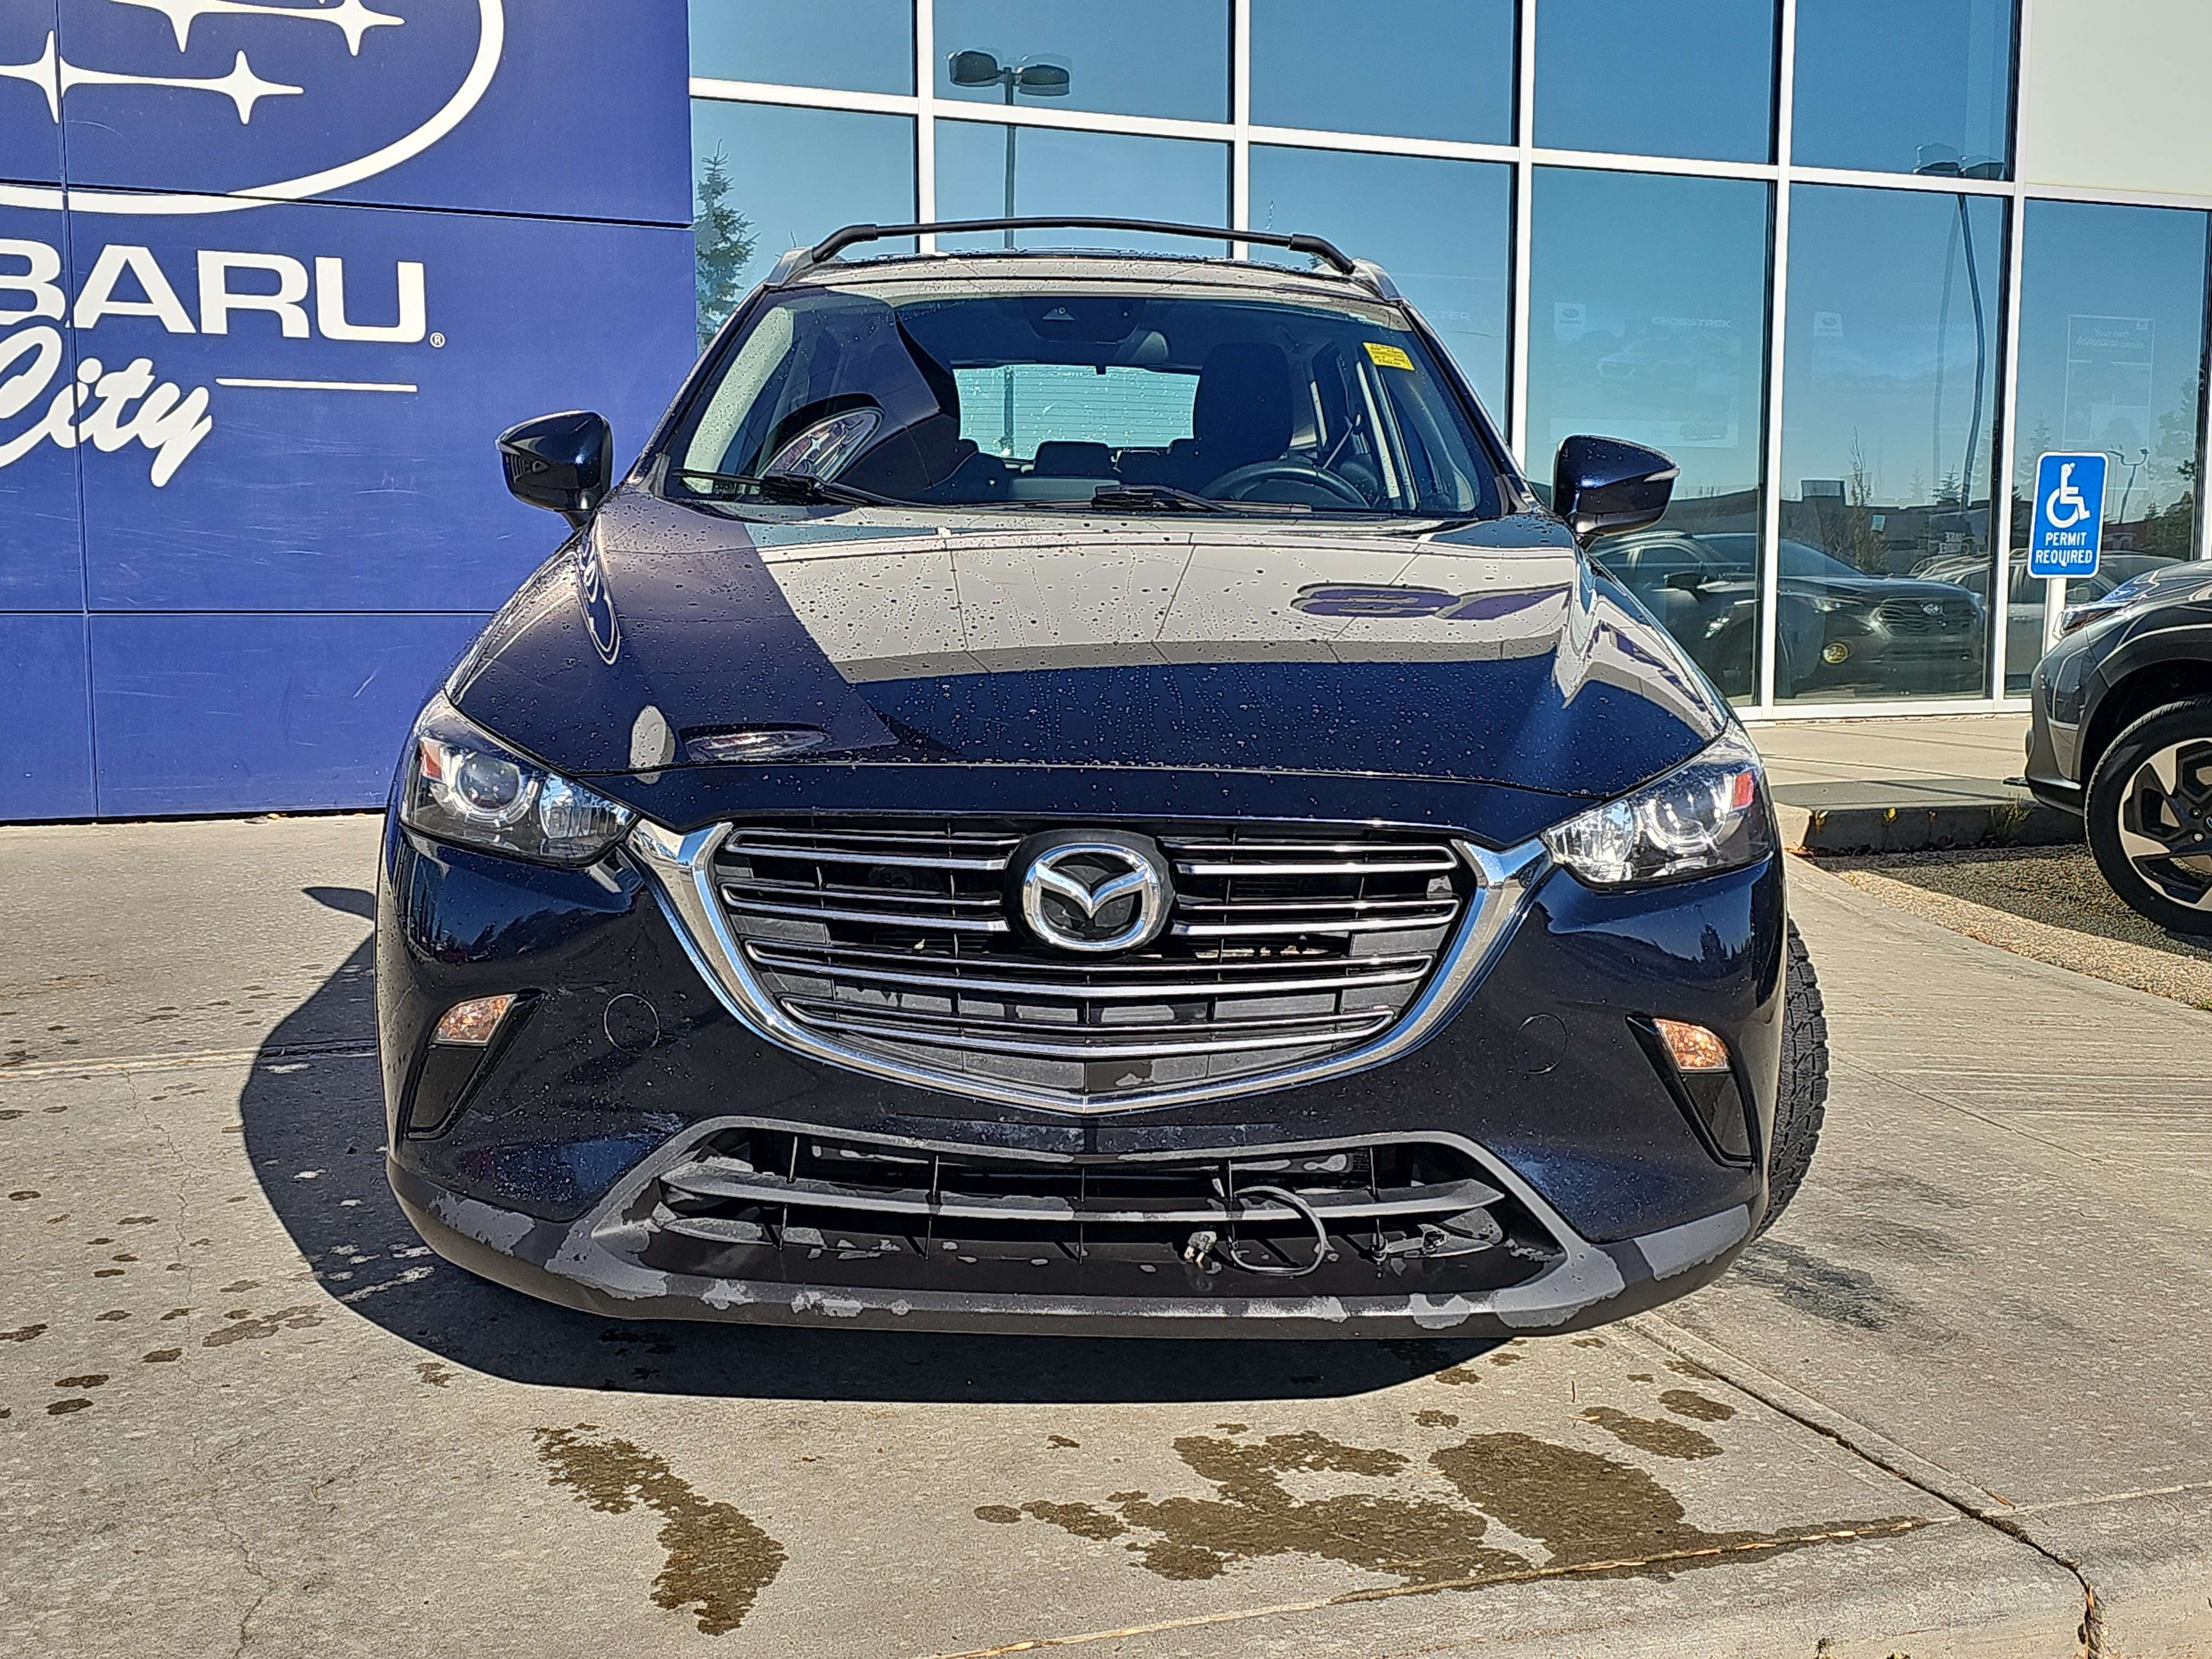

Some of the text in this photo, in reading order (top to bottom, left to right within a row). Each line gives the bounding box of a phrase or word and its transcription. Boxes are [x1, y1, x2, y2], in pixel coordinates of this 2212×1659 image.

[1652, 316, 1732, 328] CROSSTREK
[2044, 532, 2087, 546] PERMIT
[2035, 549, 2093, 564] REQUIRED
